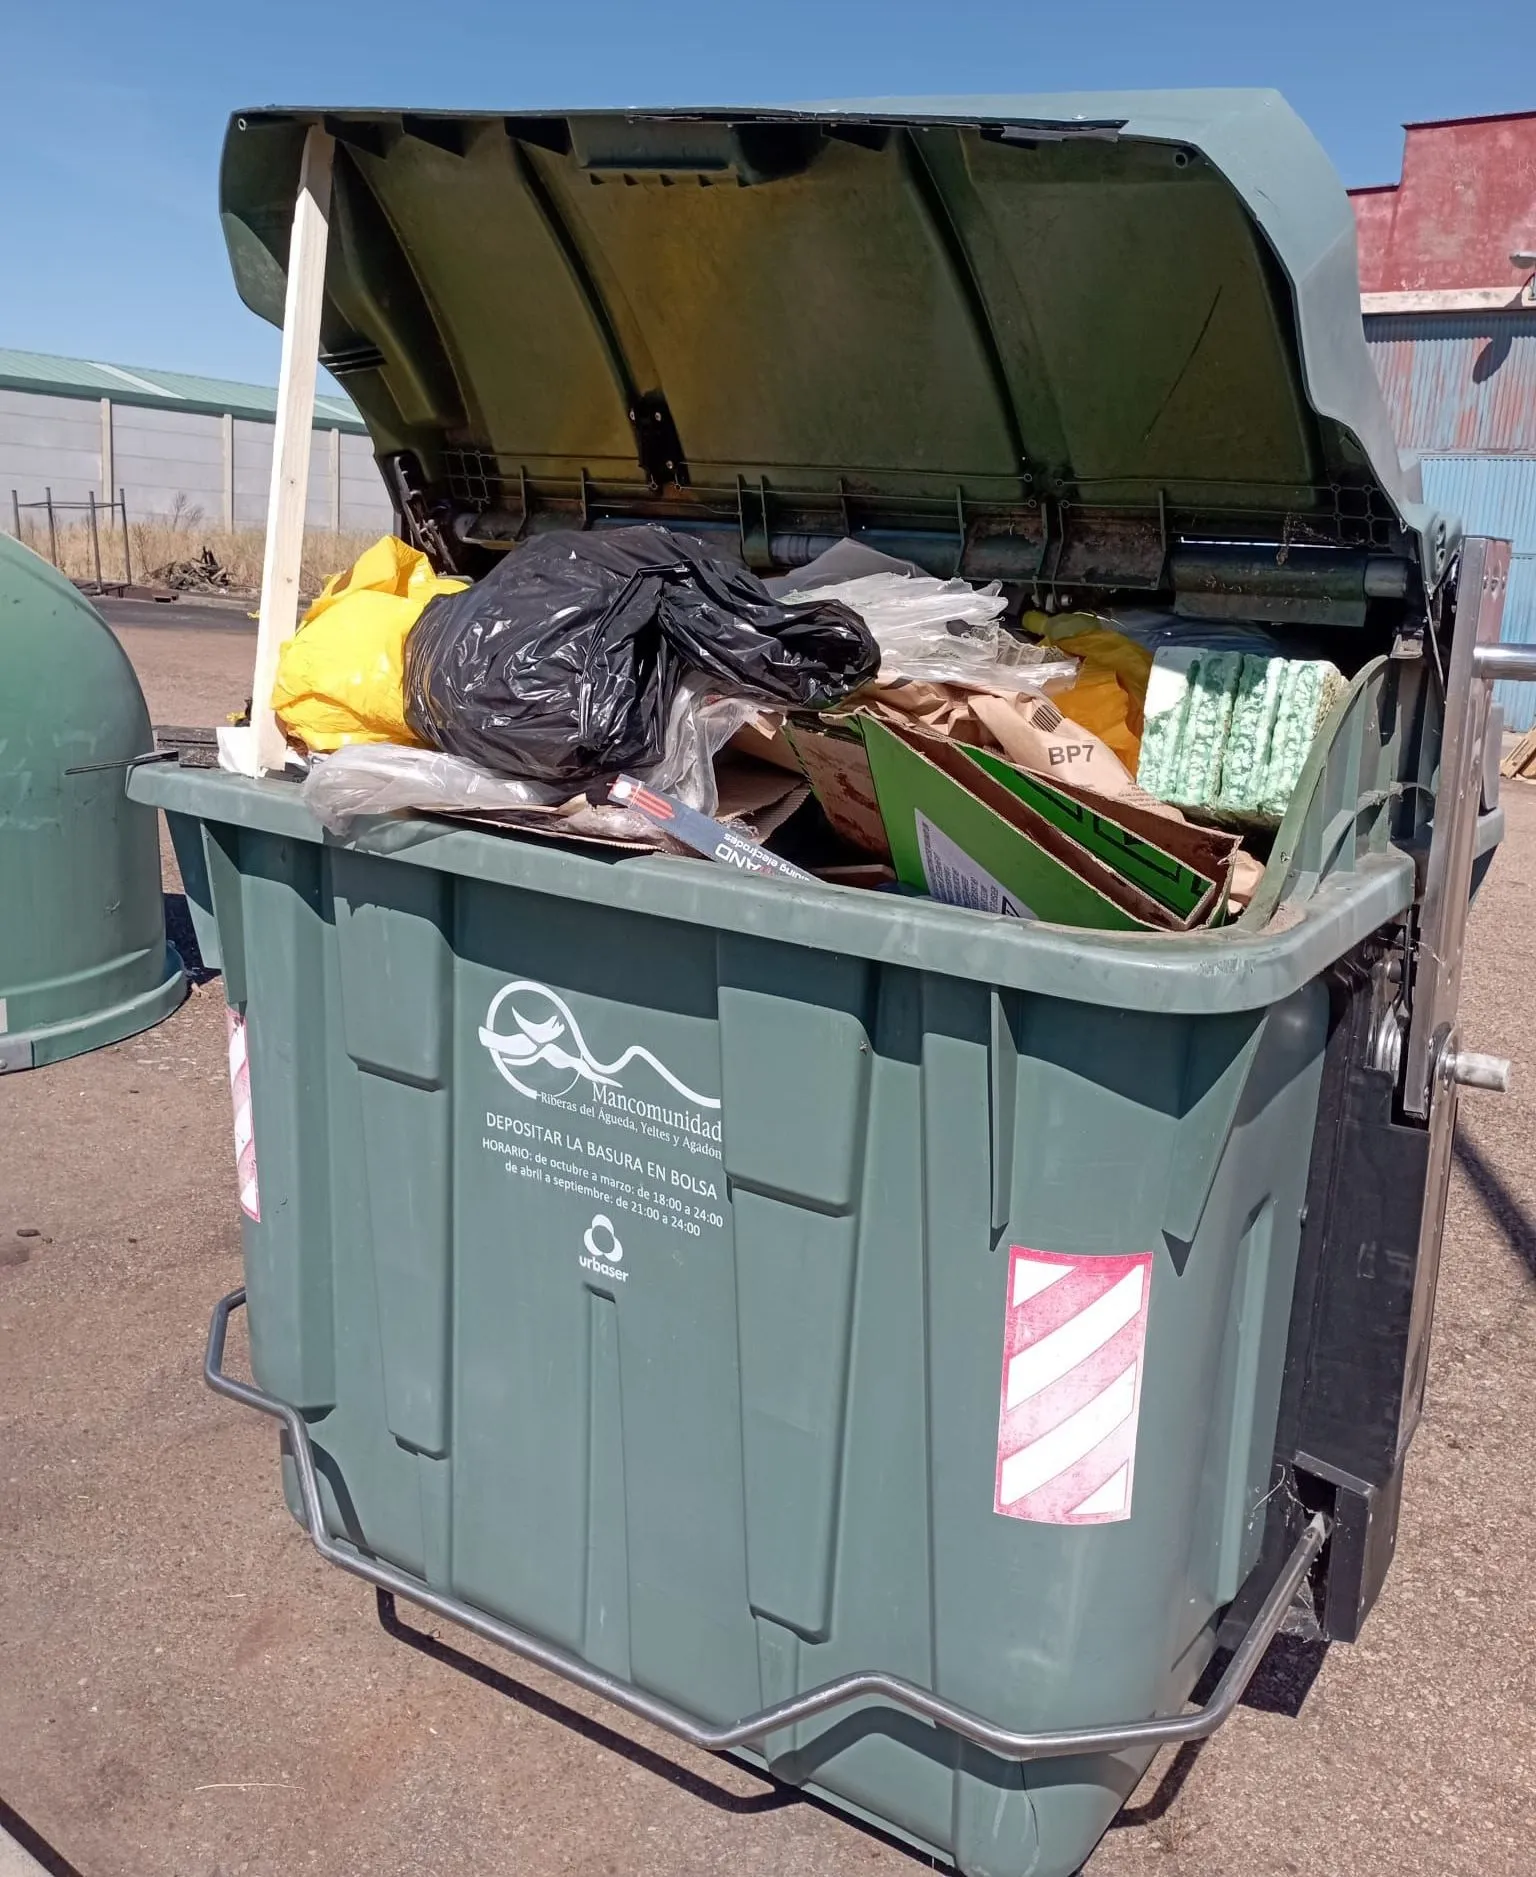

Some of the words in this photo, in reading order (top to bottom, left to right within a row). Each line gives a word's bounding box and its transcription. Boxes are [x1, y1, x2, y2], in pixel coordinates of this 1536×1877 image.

[1048, 744, 1095, 766] BP7
[724, 833, 779, 867] electrodes
[541, 1091, 577, 1112] Riberas
[579, 1104, 595, 1118] del
[641, 1121, 670, 1142] Yeltes
[673, 1134, 680, 1147] y
[592, 1081, 722, 1142] Mancomunidad
[482, 1136, 533, 1162] HORARIO:
[534, 1153, 547, 1166] de
[550, 1159, 590, 1179] octubre
[591, 1172, 598, 1182] a
[600, 1174, 635, 1195] marzo:
[637, 1186, 650, 1200] de
[653, 1191, 682, 1212] 18:00
[684, 1205, 691, 1215] a
[693, 1206, 723, 1228] 24:00
[486, 1111, 563, 1147] DEPOSITAR
[566, 1134, 583, 1153] LA
[587, 1140, 644, 1174] BASURA
[647, 1161, 666, 1182] EN
[671, 1169, 718, 1201] BOLSA
[505, 1159, 518, 1174] de
[520, 1165, 542, 1181] abril
[545, 1174, 551, 1184] a
[553, 1176, 614, 1204] septiembre:
[616, 1196, 629, 1210] de
[631, 1200, 660, 1221] 21:00
[662, 1214, 668, 1225] a
[671, 1215, 701, 1237] 24:00
[579, 1255, 629, 1282] urbaser
